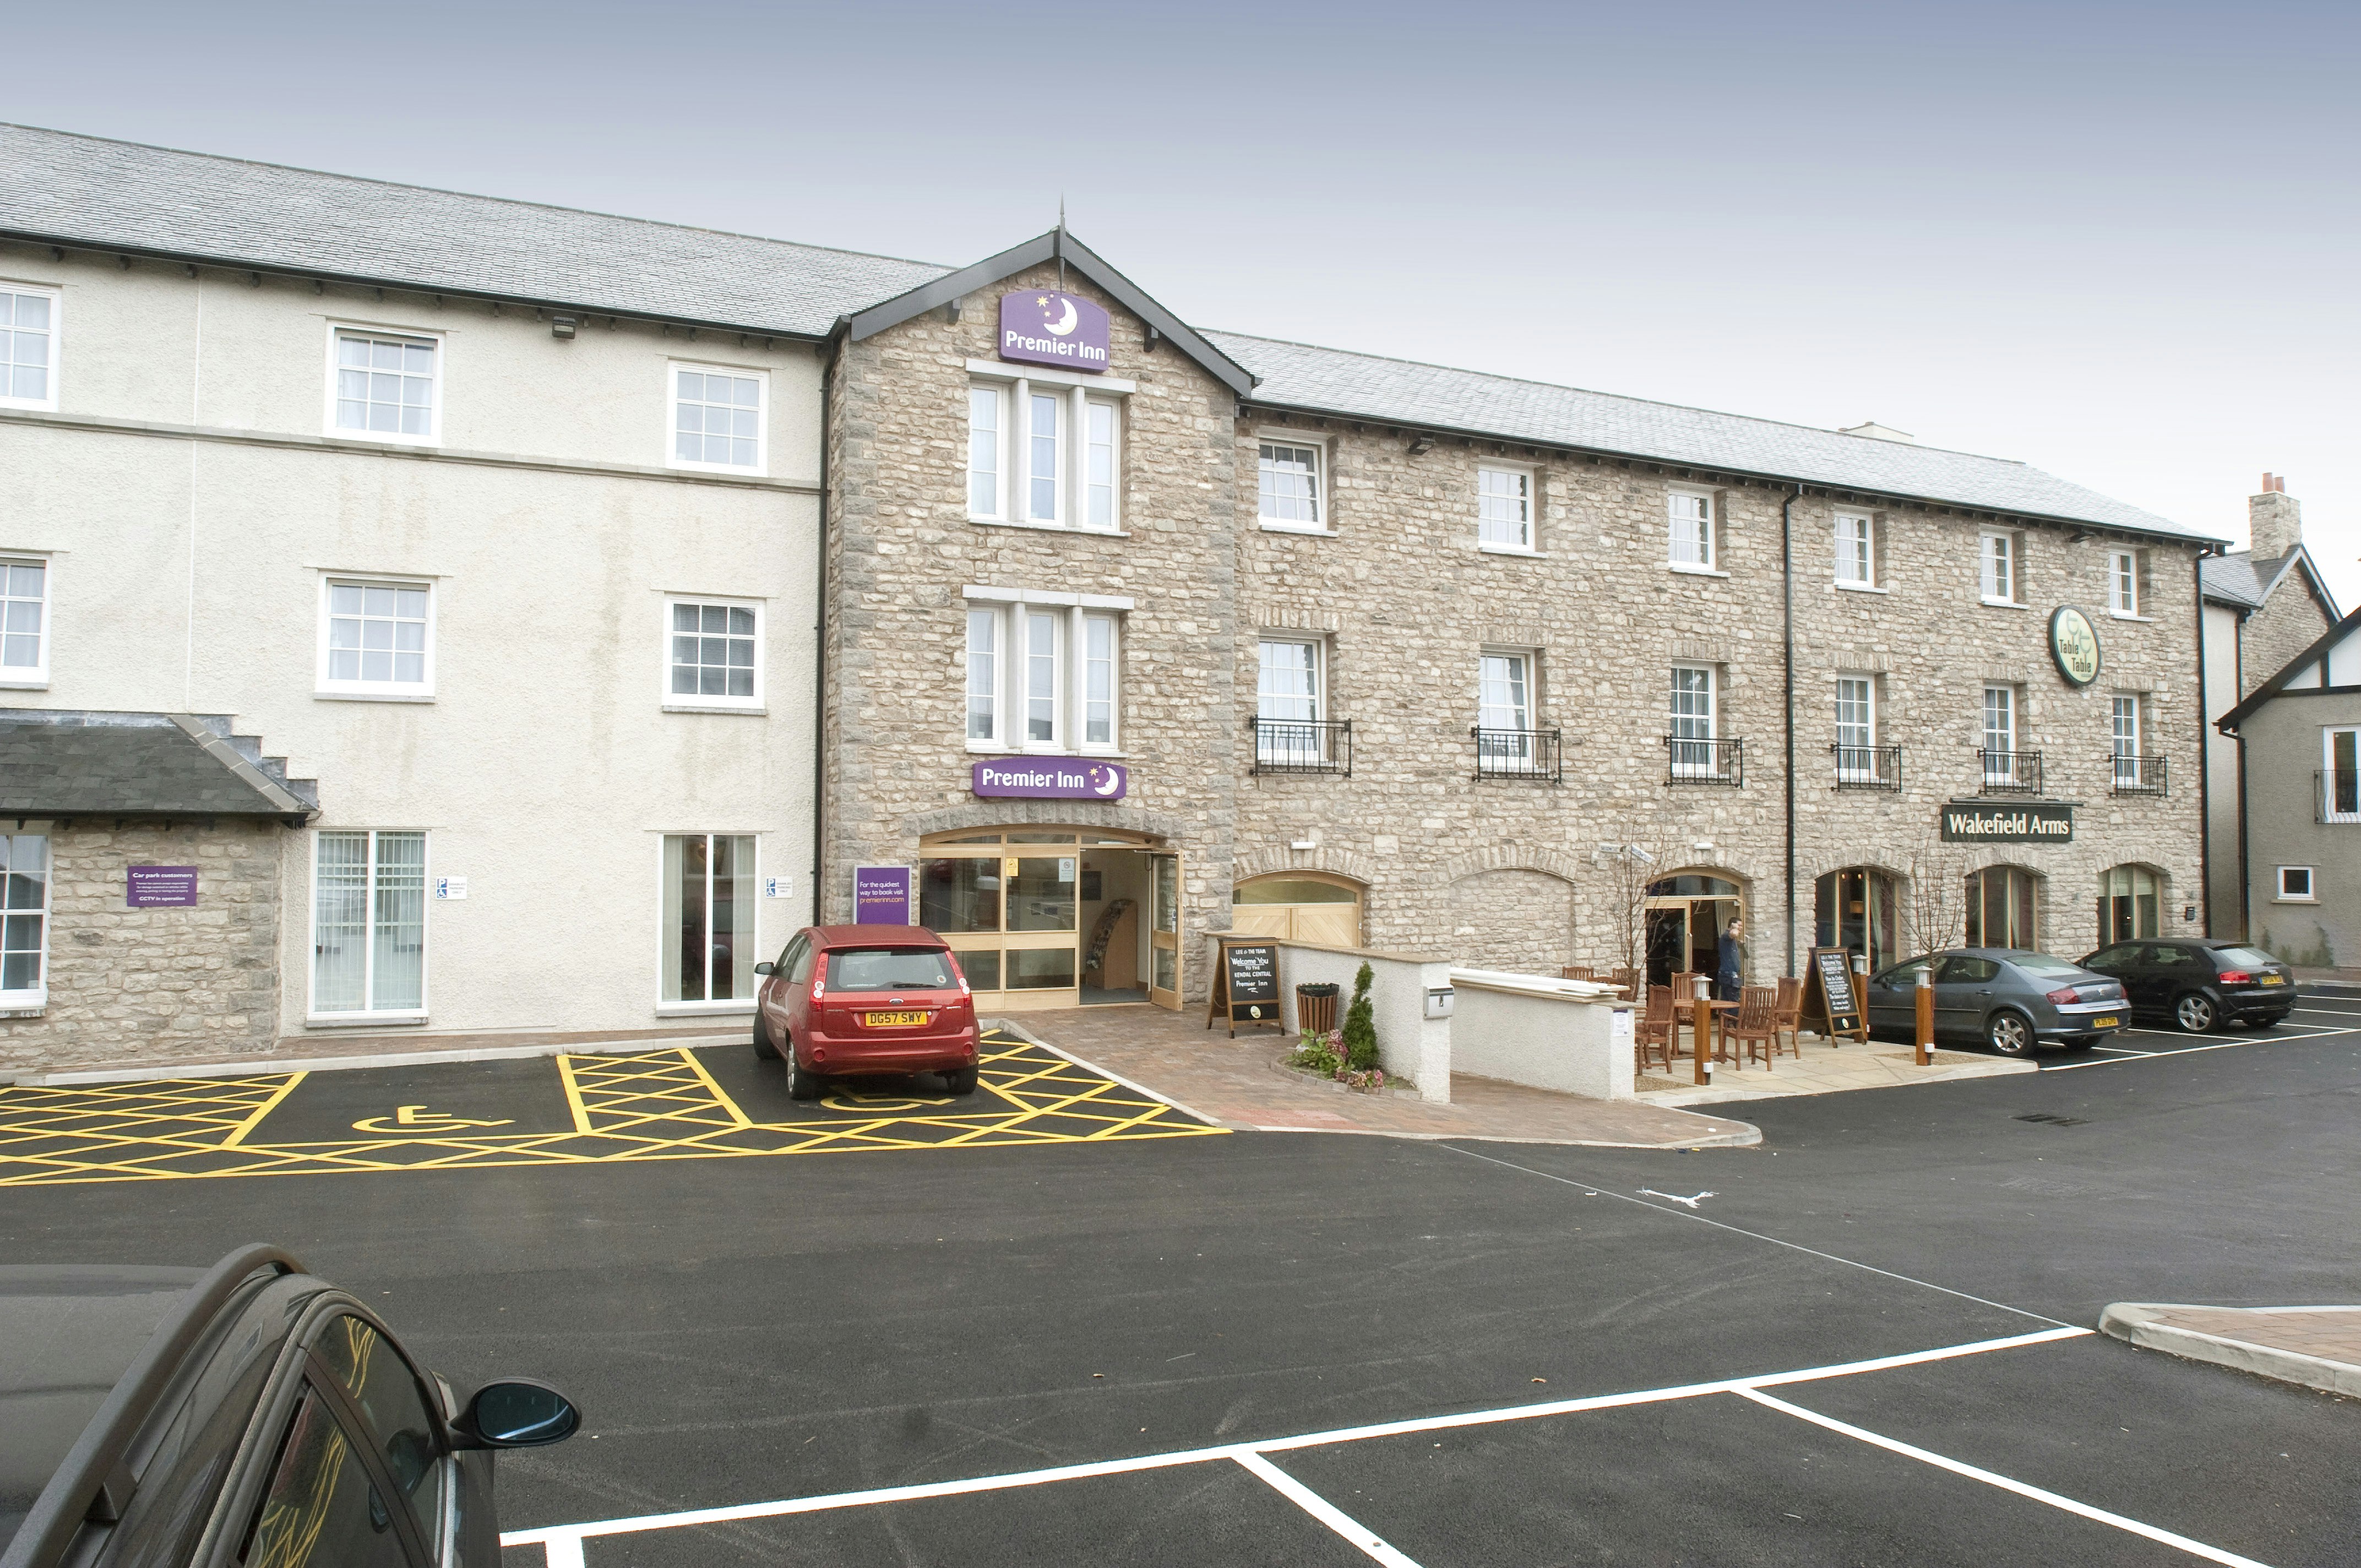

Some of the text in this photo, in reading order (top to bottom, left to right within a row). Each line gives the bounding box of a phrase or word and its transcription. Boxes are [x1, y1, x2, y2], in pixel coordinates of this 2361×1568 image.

[1005, 330, 1106, 361] Premier Inn
[2059, 639, 2079, 655] Table
[2071, 657, 2091, 672] Table
[982, 769, 1084, 788] Premier Inn
[1949, 812, 2070, 834] Wakefield Arms
[870, 1012, 922, 1023] DG57 SWY
